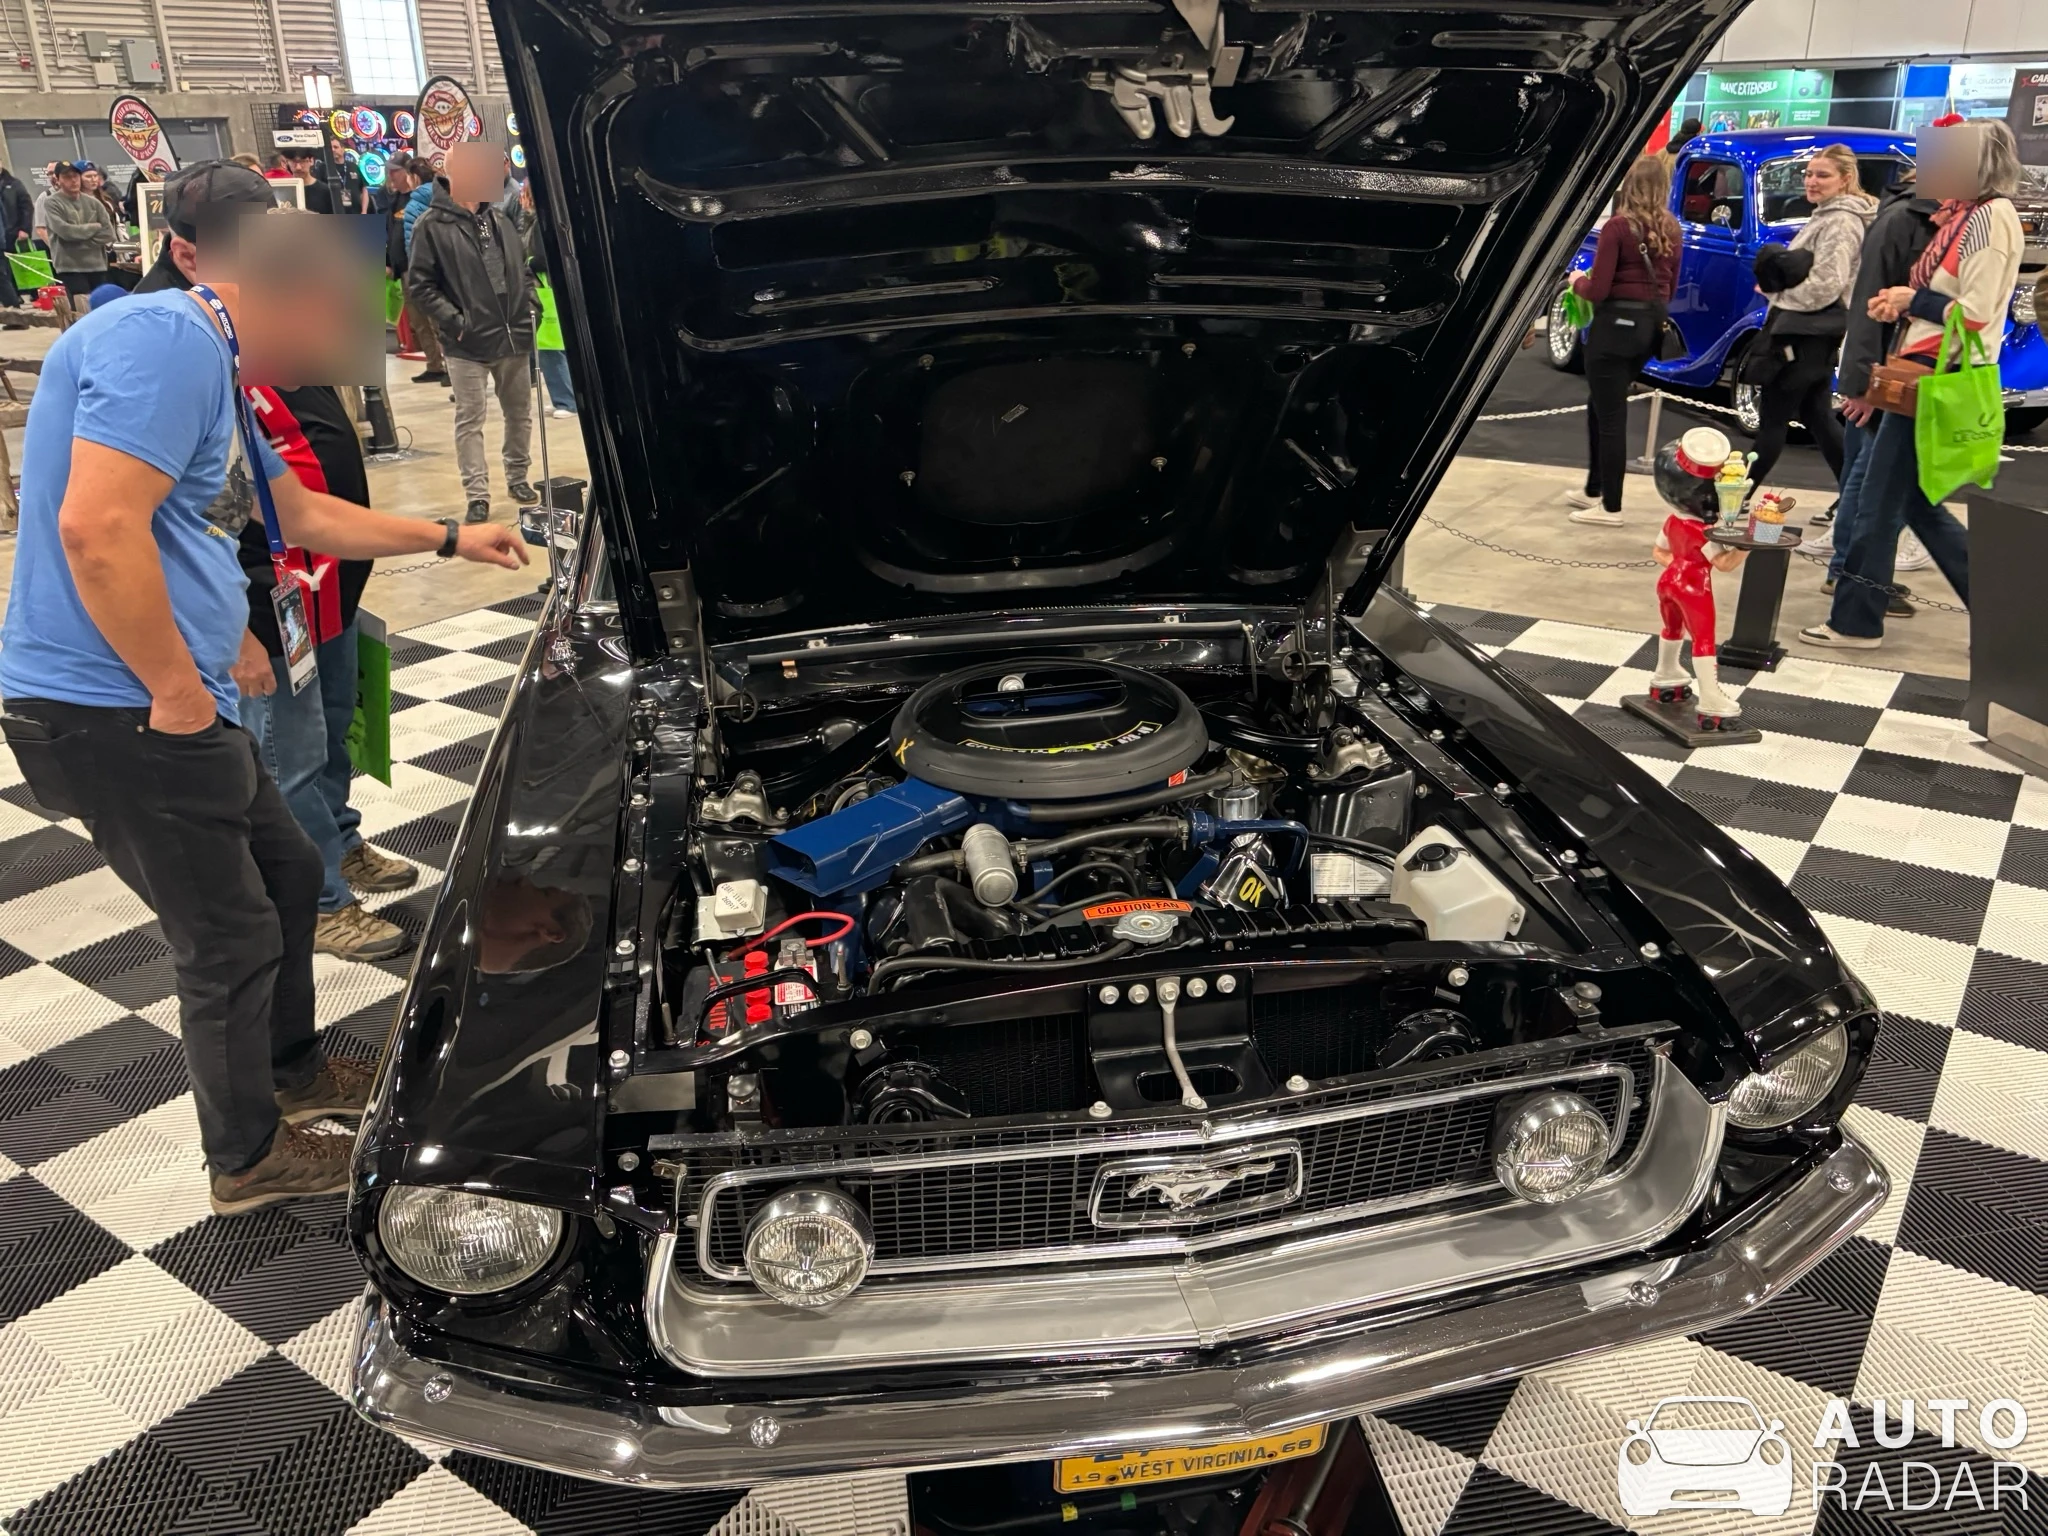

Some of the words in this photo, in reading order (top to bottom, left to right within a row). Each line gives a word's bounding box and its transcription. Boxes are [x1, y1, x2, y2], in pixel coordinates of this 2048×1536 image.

[1097, 900, 1180, 915] CAUTION-FAN
[1239, 876, 1267, 908] OK
[1072, 1472, 1101, 1485] 19
[1119, 1460, 1174, 1480] WEST
[1183, 1446, 1266, 1470] VIRGINIA
[1281, 1439, 1312, 1453] 68
